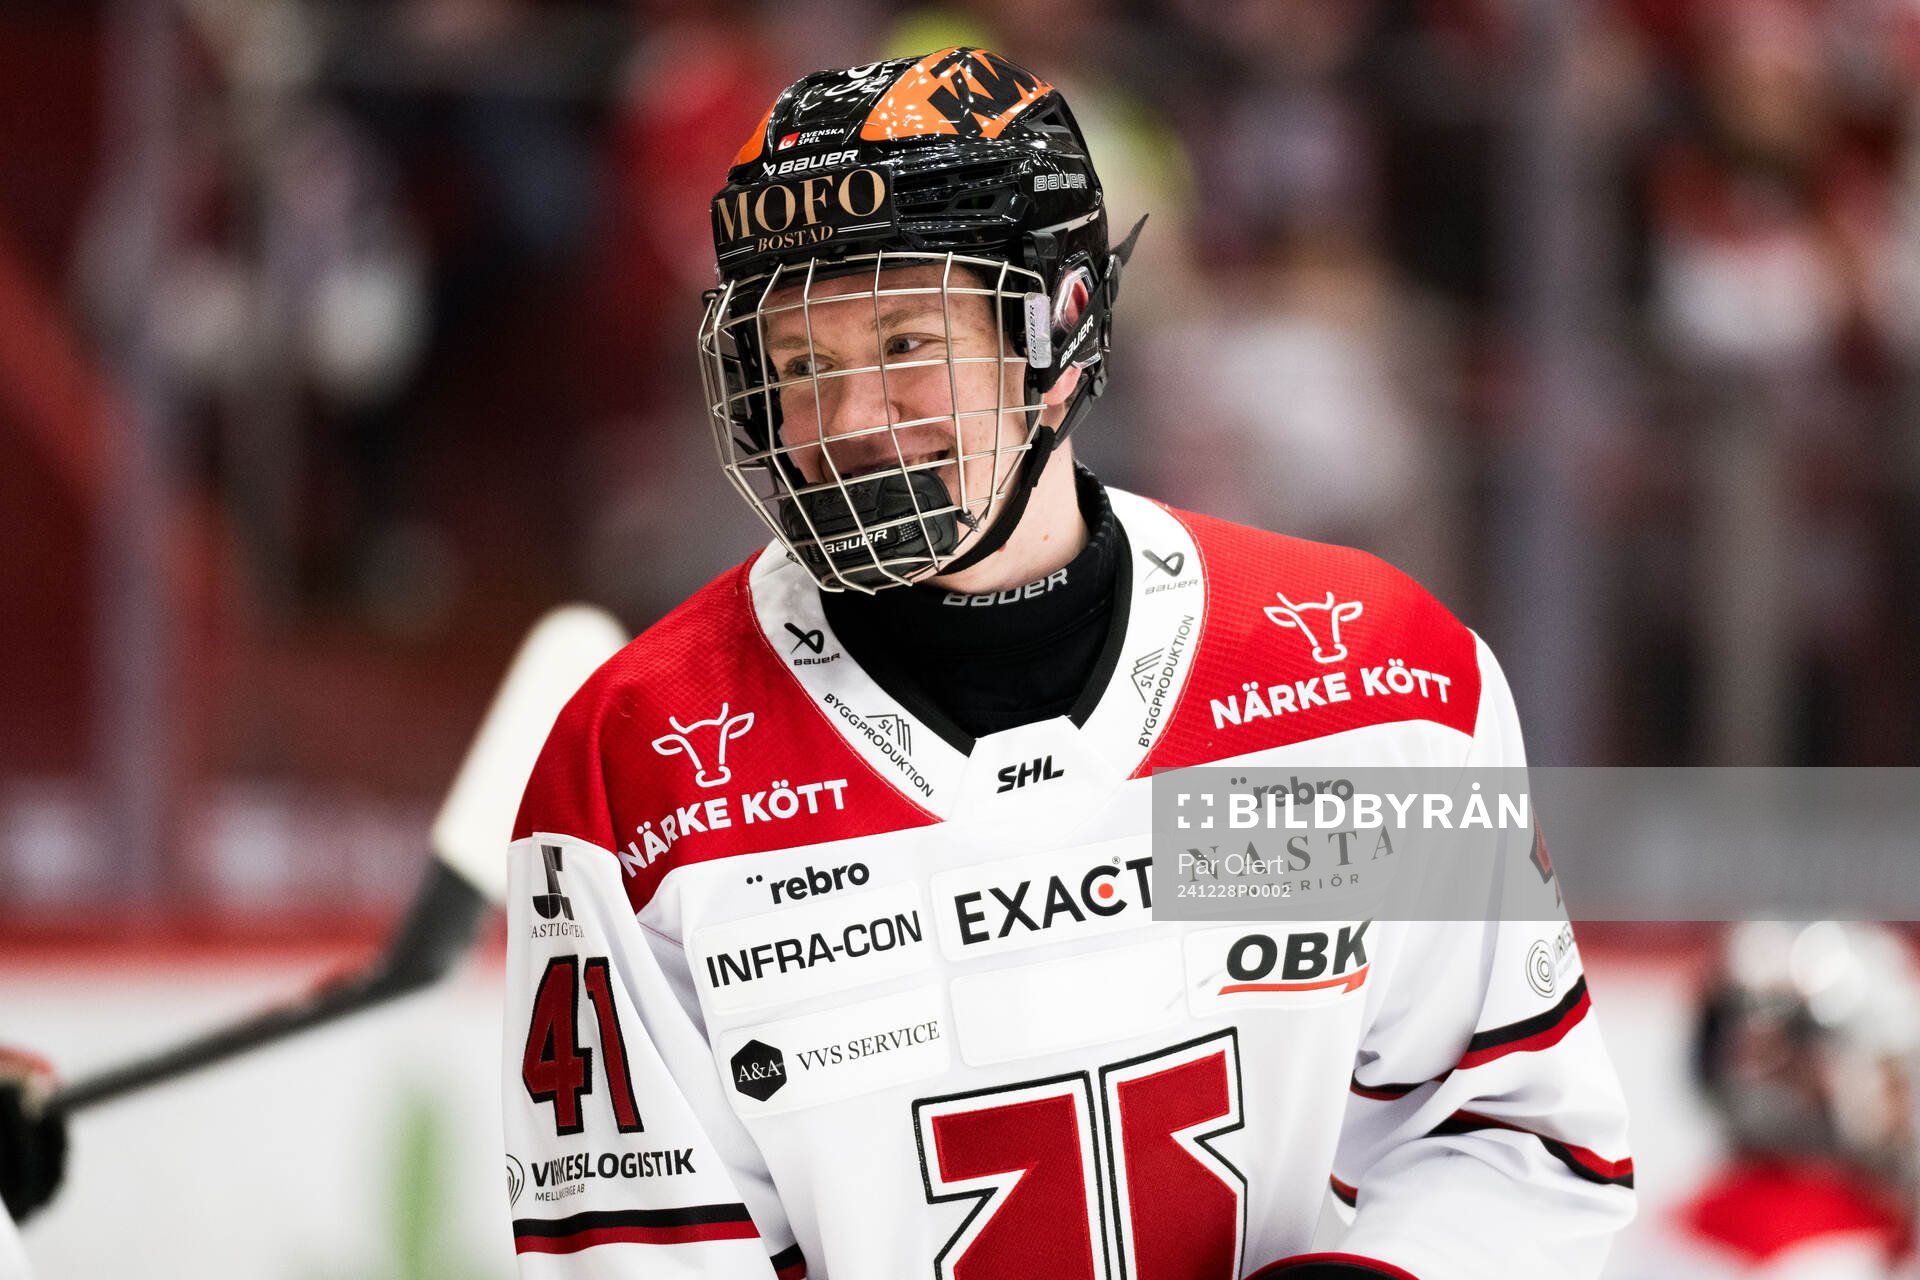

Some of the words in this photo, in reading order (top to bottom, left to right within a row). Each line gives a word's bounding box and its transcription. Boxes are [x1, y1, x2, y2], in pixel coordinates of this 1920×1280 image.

[797, 136, 821, 146] SPEL
[801, 128, 845, 139] SVENSKA
[778, 149, 859, 175] BAUER
[1034, 173, 1088, 192] BAUER
[717, 168, 886, 246] MOFO
[758, 225, 834, 253] BOSTAD
[1060, 314, 1094, 369] BAUER
[1145, 578, 1198, 595] BAUER
[793, 653, 841, 666] BAUER
[1138, 614, 1195, 748] BYGGPRODUKTION
[1140, 671, 1155, 689] SL
[1209, 671, 1351, 730] NÄRKE
[1360, 658, 1451, 704] KÖTT
[823, 693, 934, 798] BYGGPRODUKTION
[878, 719, 893, 736] SL
[996, 754, 1065, 794] SHL
[1230, 775, 1355, 809] rebro
[618, 797, 732, 878] NÄRKE
[741, 778, 849, 825] KÖTT
[1186, 825, 1394, 883] NASTA
[746, 862, 870, 905] rebro
[954, 856, 1153, 946] EXACT
[706, 910, 923, 988] INFRA-CON
[1226, 917, 1374, 982] OBK
[522, 954, 645, 1137] 41
[737, 1059, 783, 1083] A&A
[796, 1045, 843, 1071] VVS
[848, 1020, 940, 1061] SERVICE
[531, 1148, 697, 1187] VIRKESLOGISTIK
